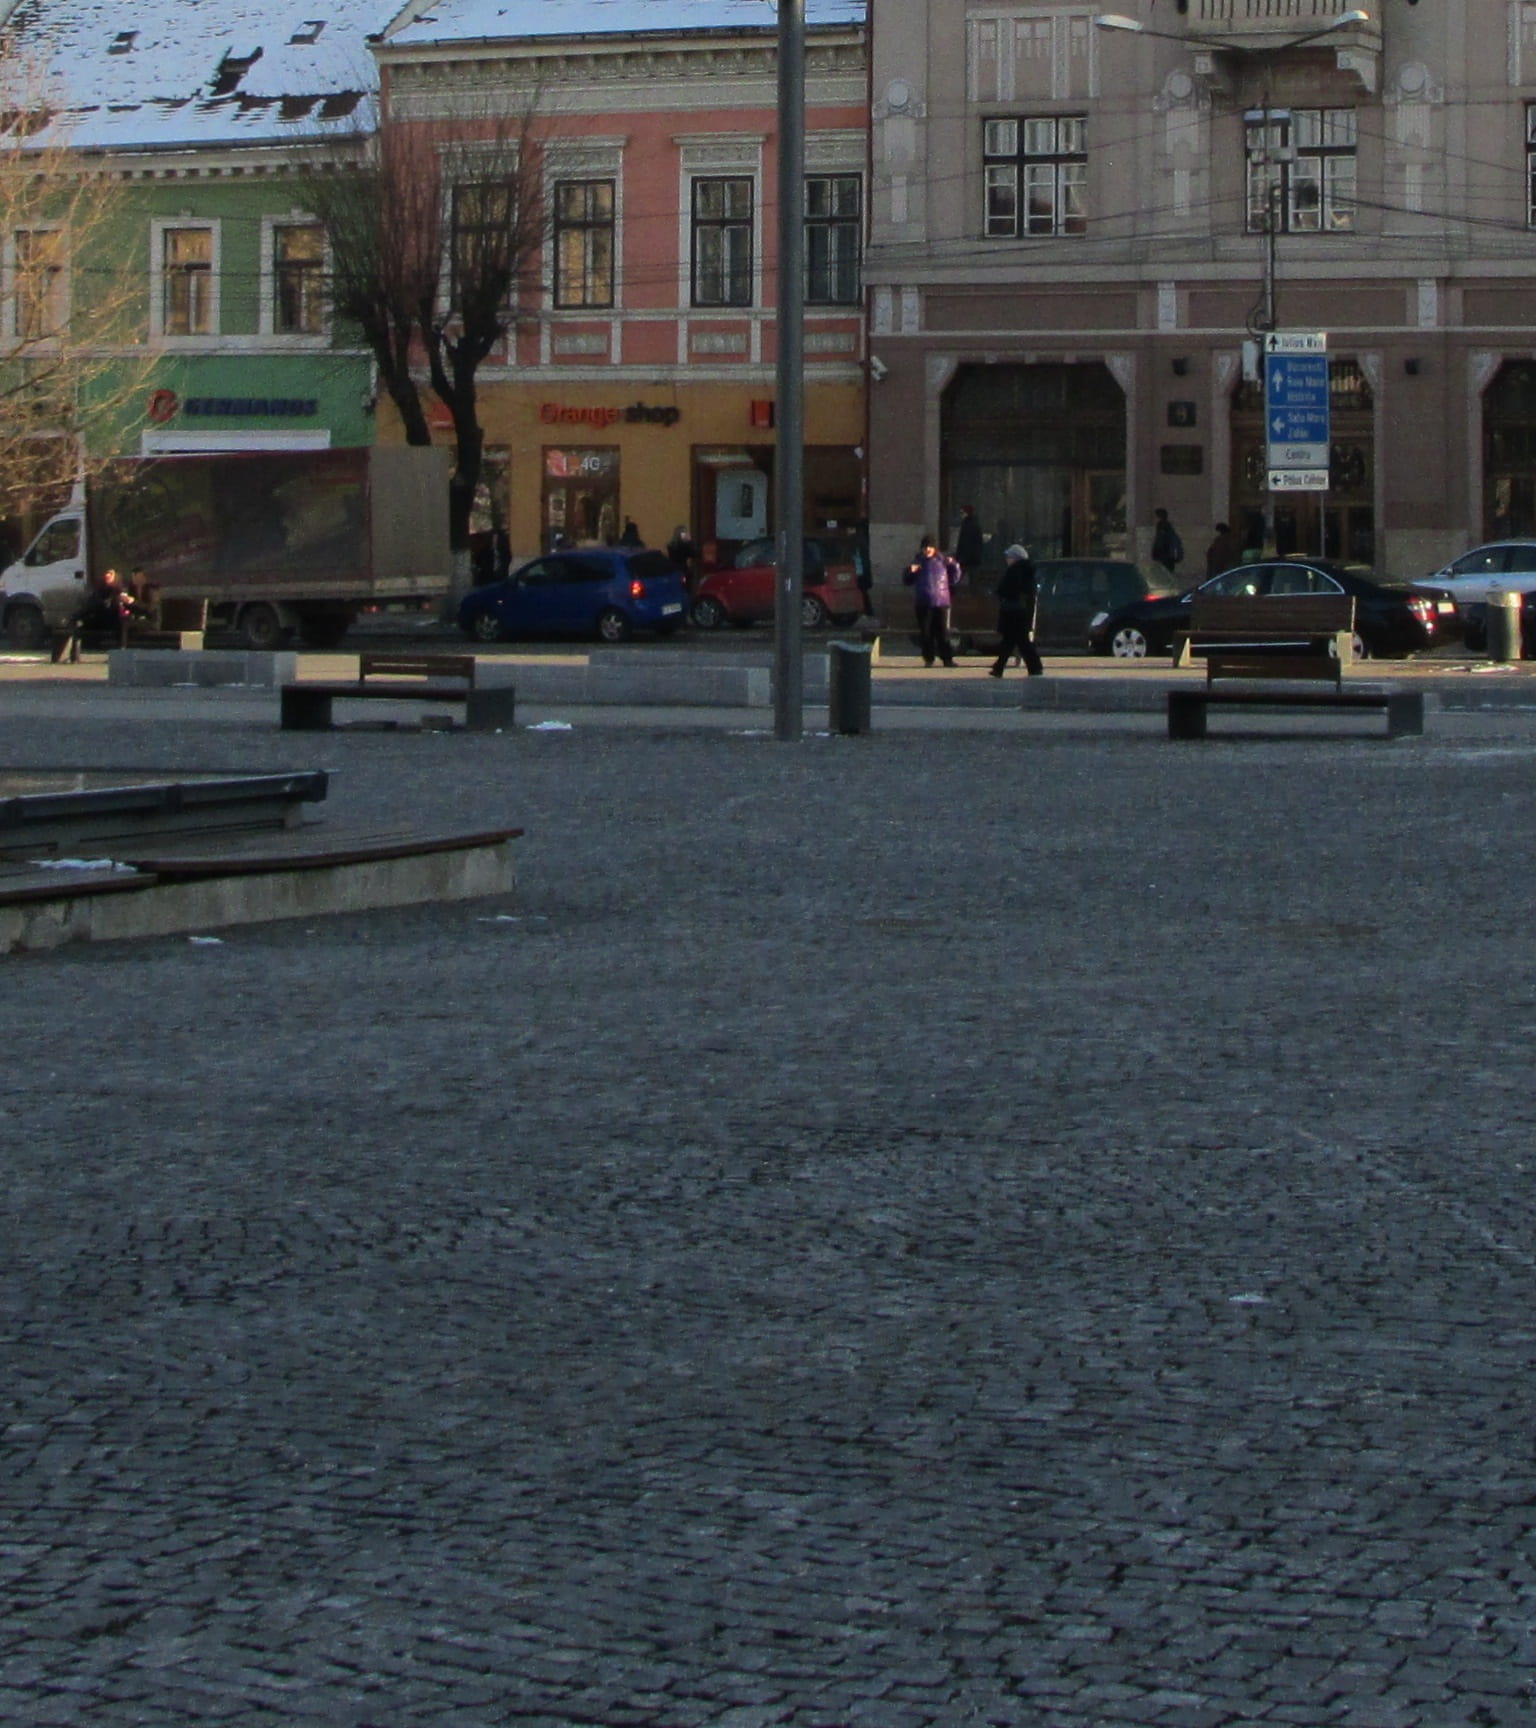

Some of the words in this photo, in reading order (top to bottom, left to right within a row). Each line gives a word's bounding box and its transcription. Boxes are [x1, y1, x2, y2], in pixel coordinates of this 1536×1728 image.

[540, 402, 620, 429] Orange
[625, 401, 681, 427] shop
[580, 456, 601, 471] 4G
